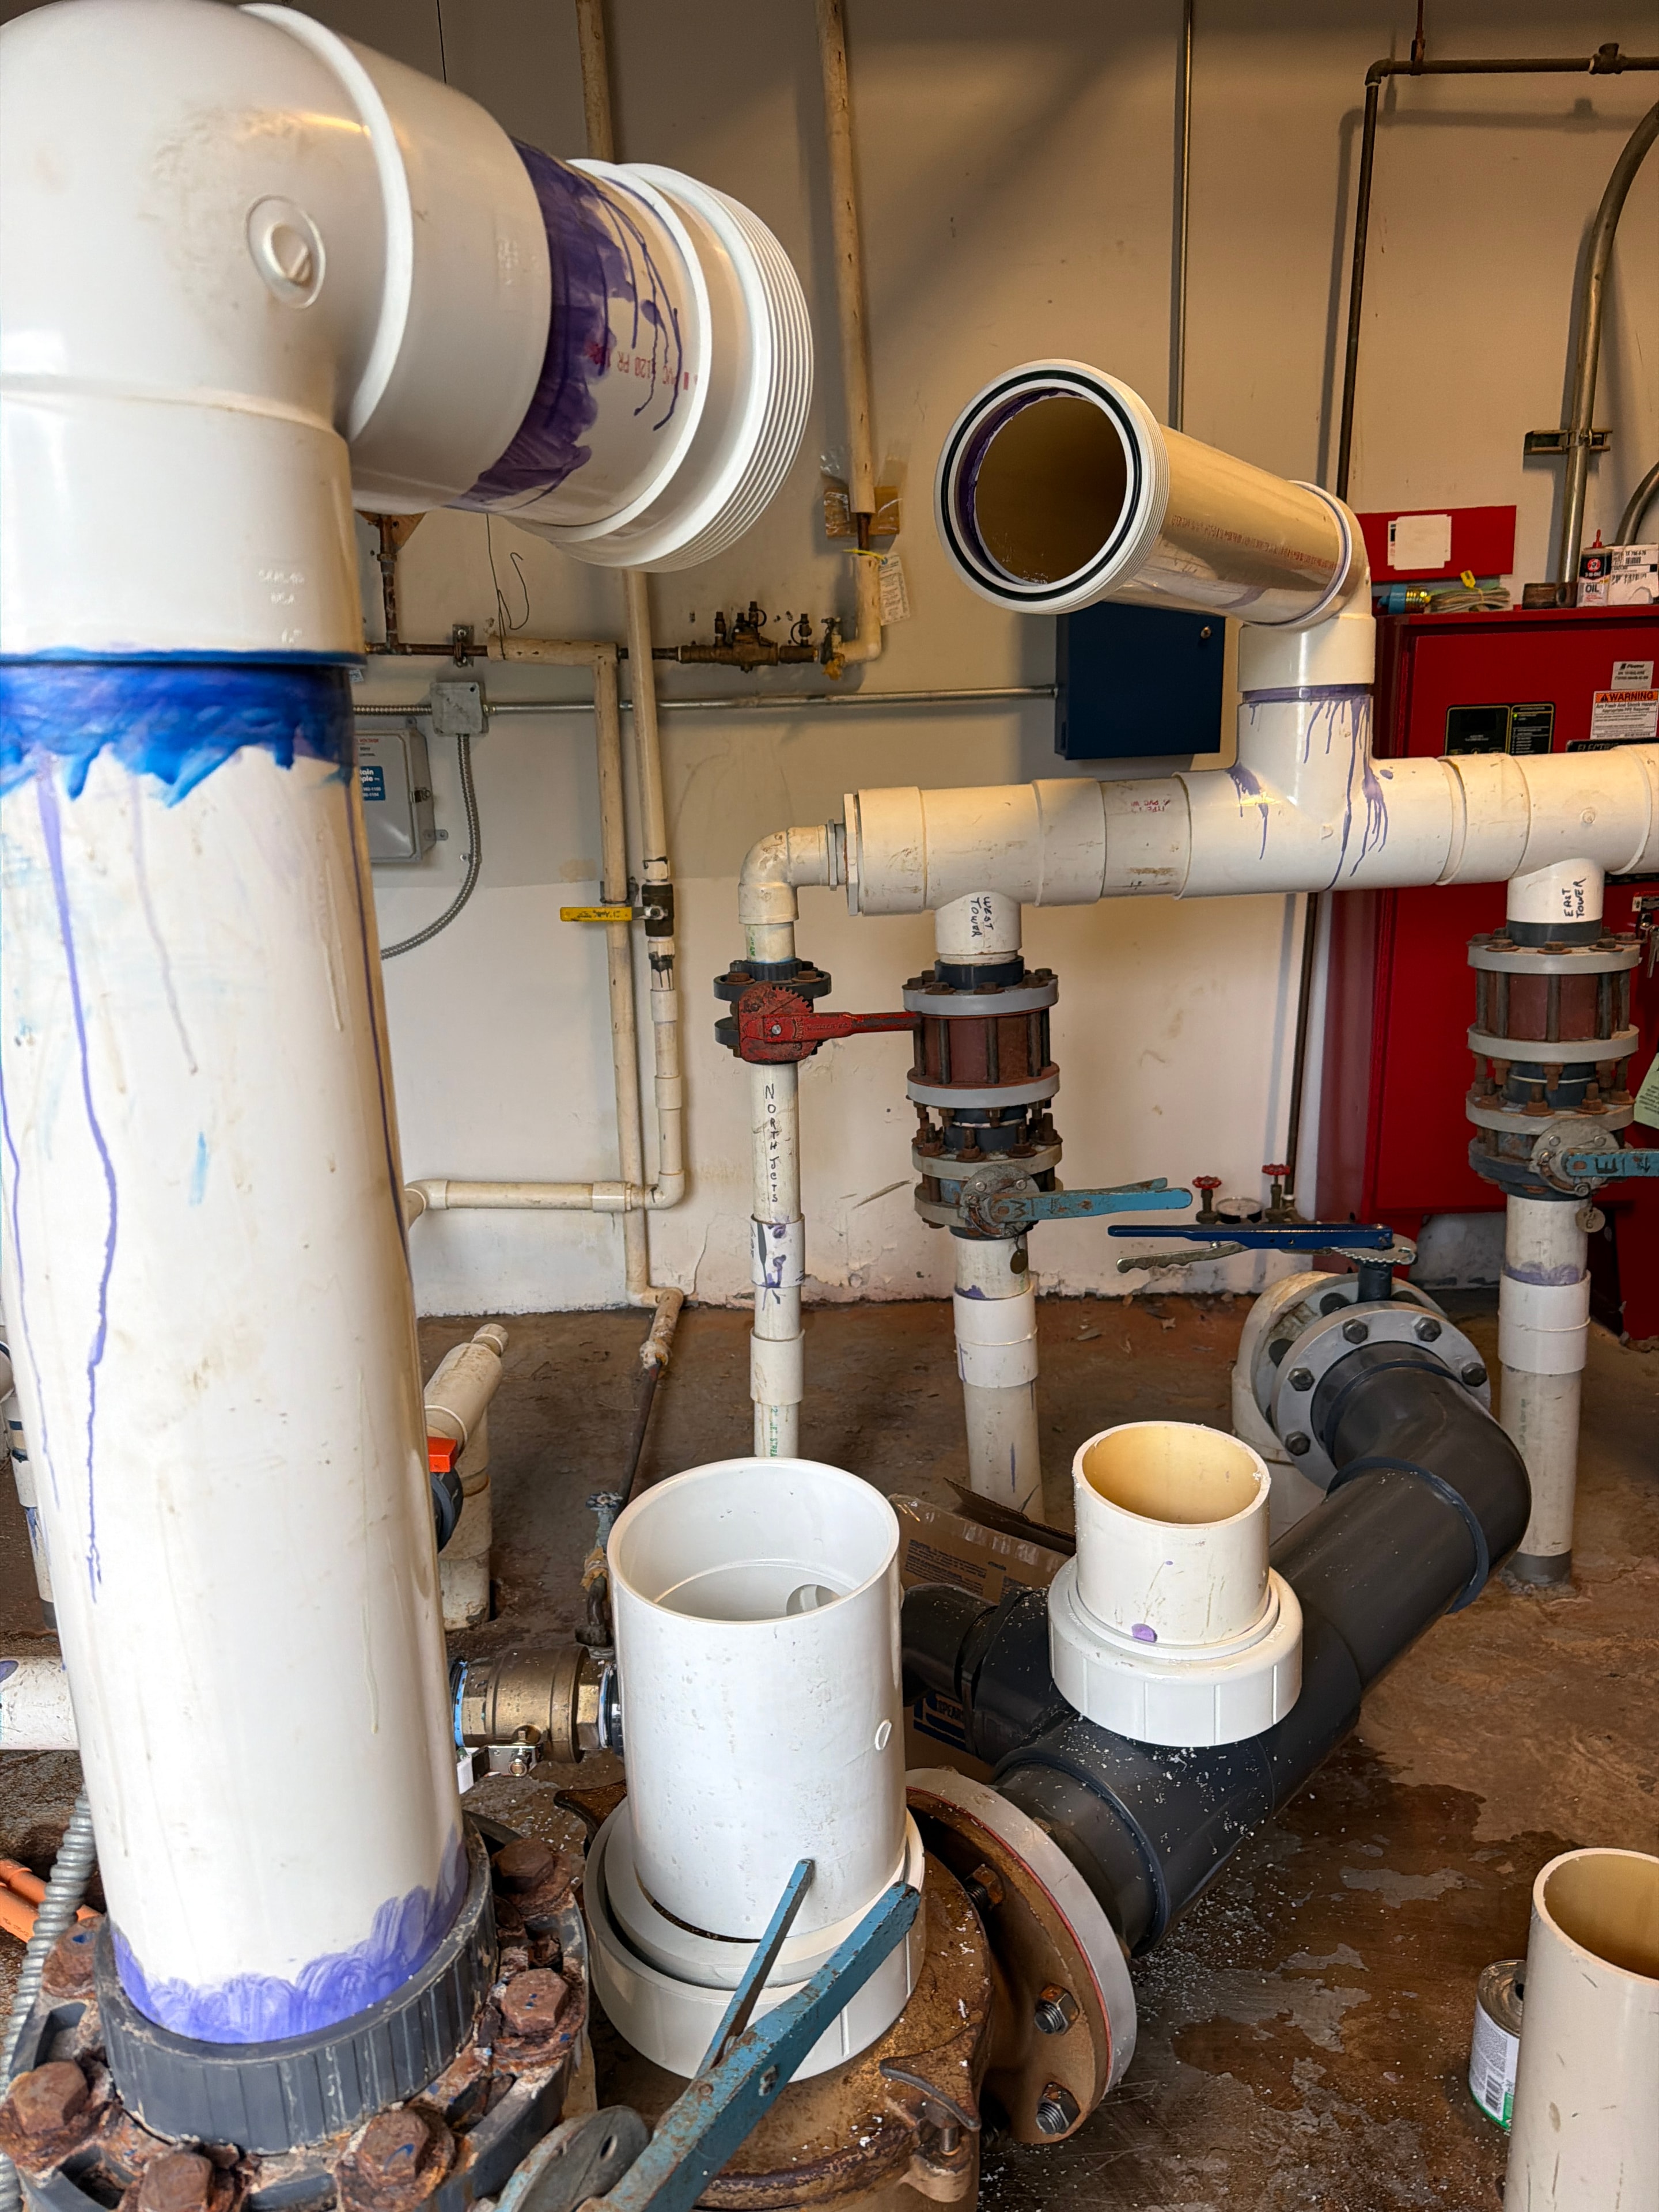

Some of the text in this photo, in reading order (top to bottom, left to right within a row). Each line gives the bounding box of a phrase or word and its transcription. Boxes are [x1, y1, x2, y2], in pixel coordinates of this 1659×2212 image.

[1585, 584, 1599, 593] OIL
[1609, 691, 1653, 702] WARNING
[1562, 888, 1574, 917] EAST
[1573, 878, 1586, 918] TOWER
[970, 897, 983, 938] TOWER
[765, 1083, 779, 1150] NORTH
[770, 1437, 778, 1457] STREA
